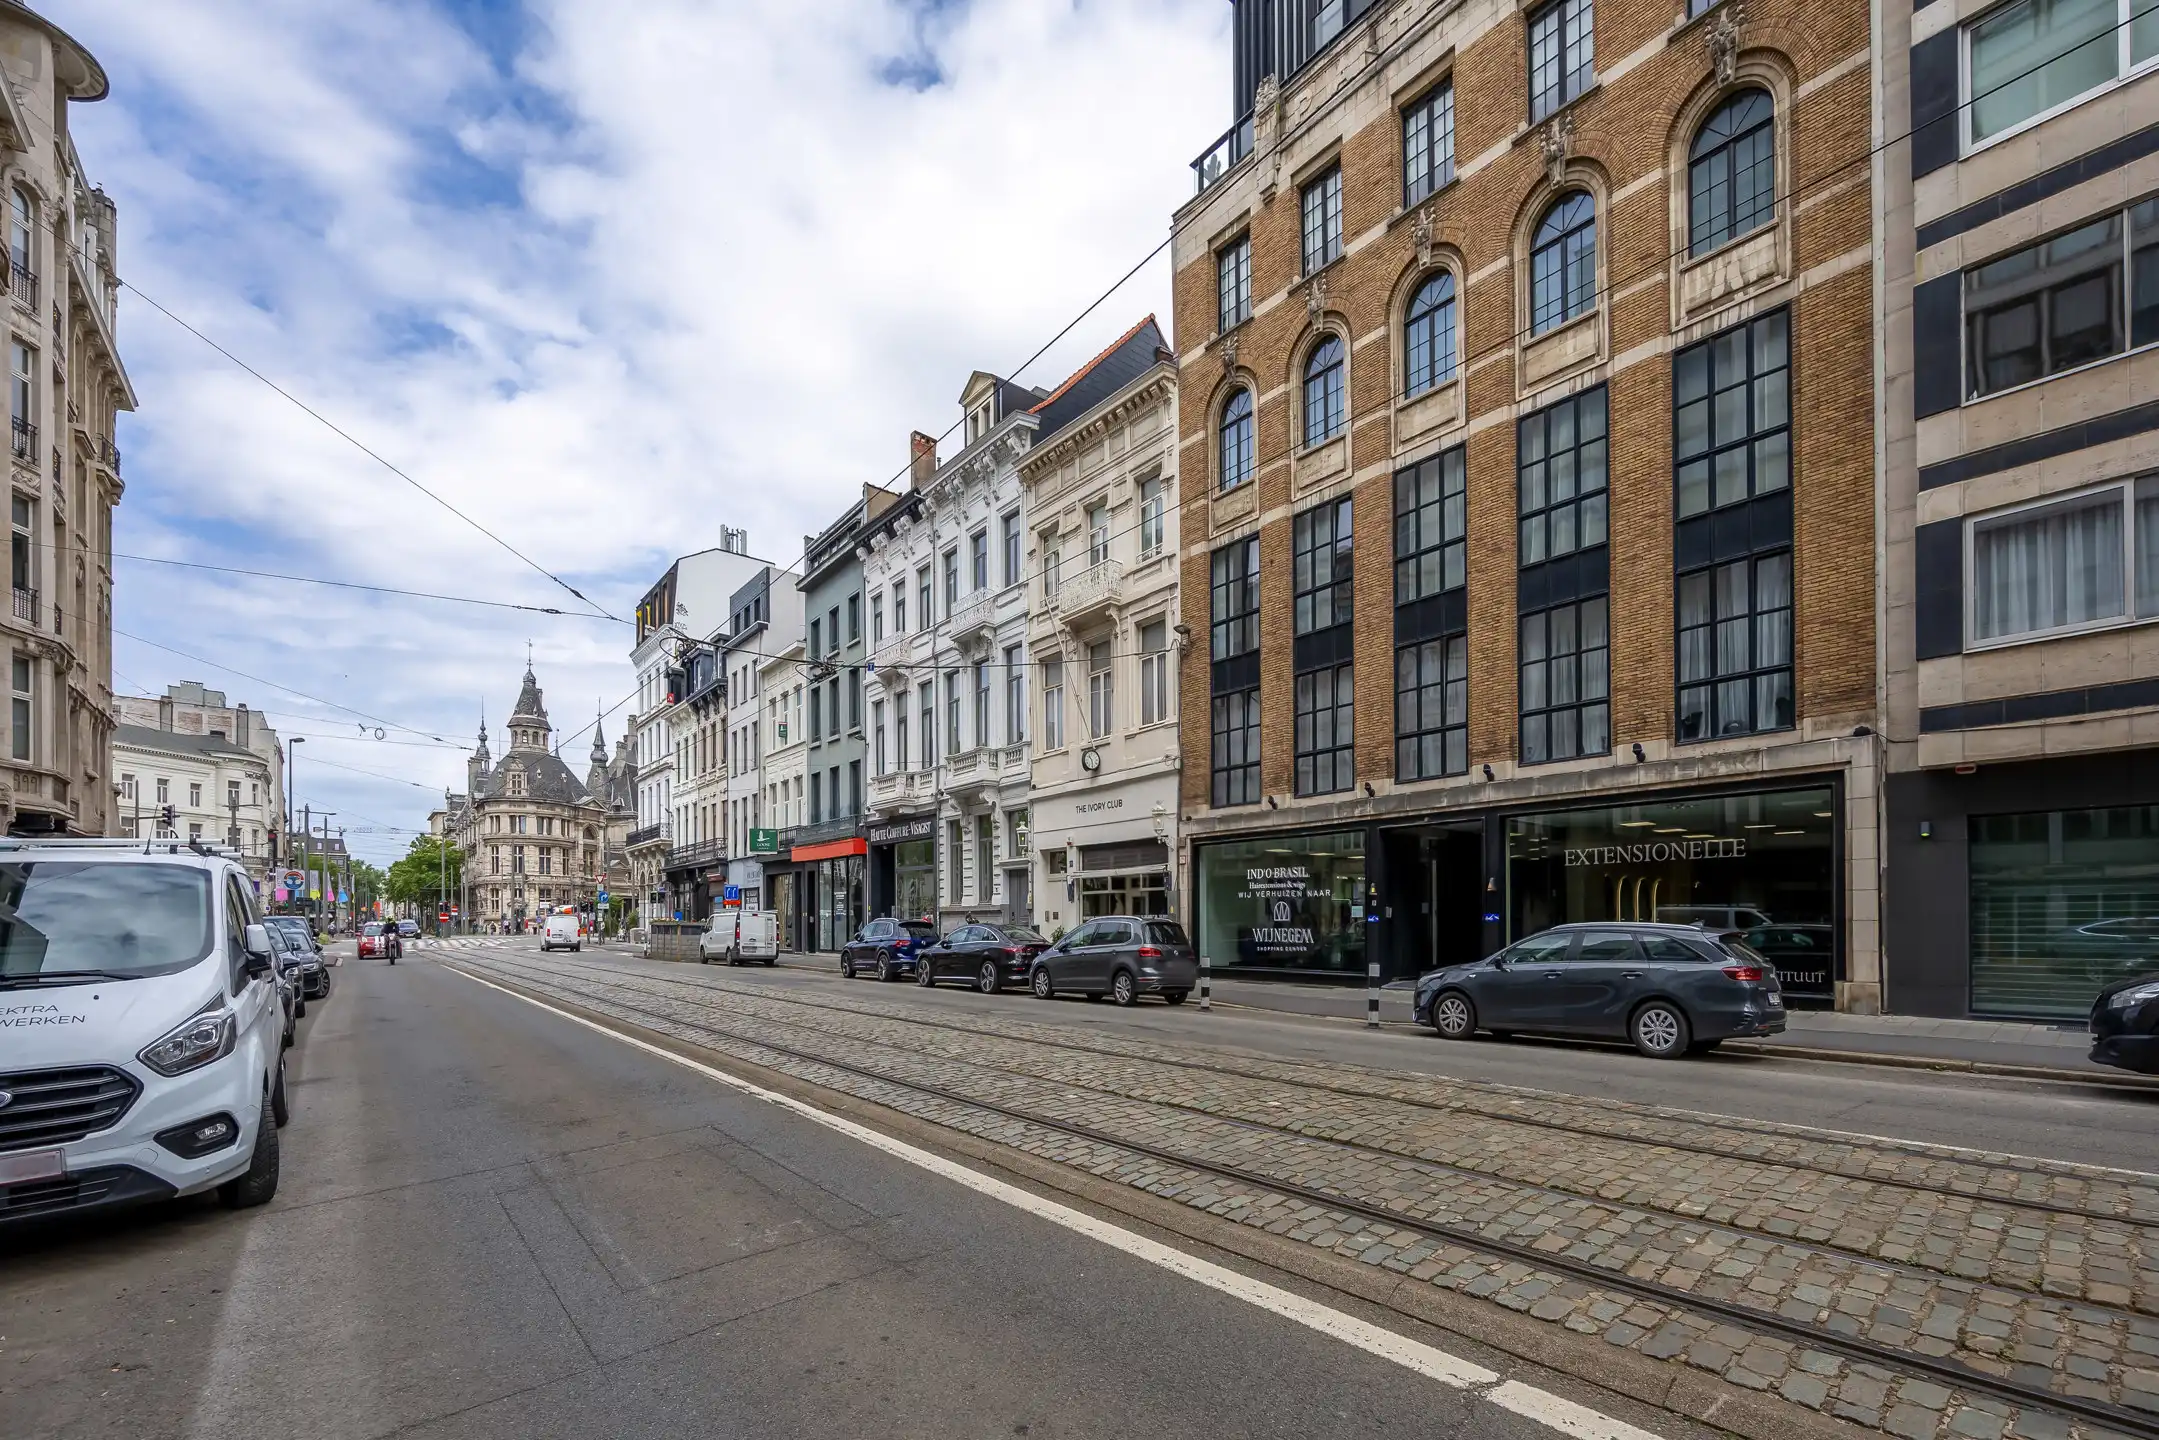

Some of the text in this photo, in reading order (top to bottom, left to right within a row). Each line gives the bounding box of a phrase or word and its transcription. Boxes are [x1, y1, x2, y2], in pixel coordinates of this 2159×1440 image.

[1076, 799, 1123, 814] THE IVORY CLUB
[1564, 838, 1747, 867] EXTENSIONELLE
[1247, 868, 1272, 880] IND'O
[1238, 889, 1331, 899] WIJ VERHUIZEN NAAR
[1252, 927, 1314, 944] WIJNEGEM
[1776, 970, 1826, 983] ITUUT
[0, 1015, 85, 1027] WERKEN
